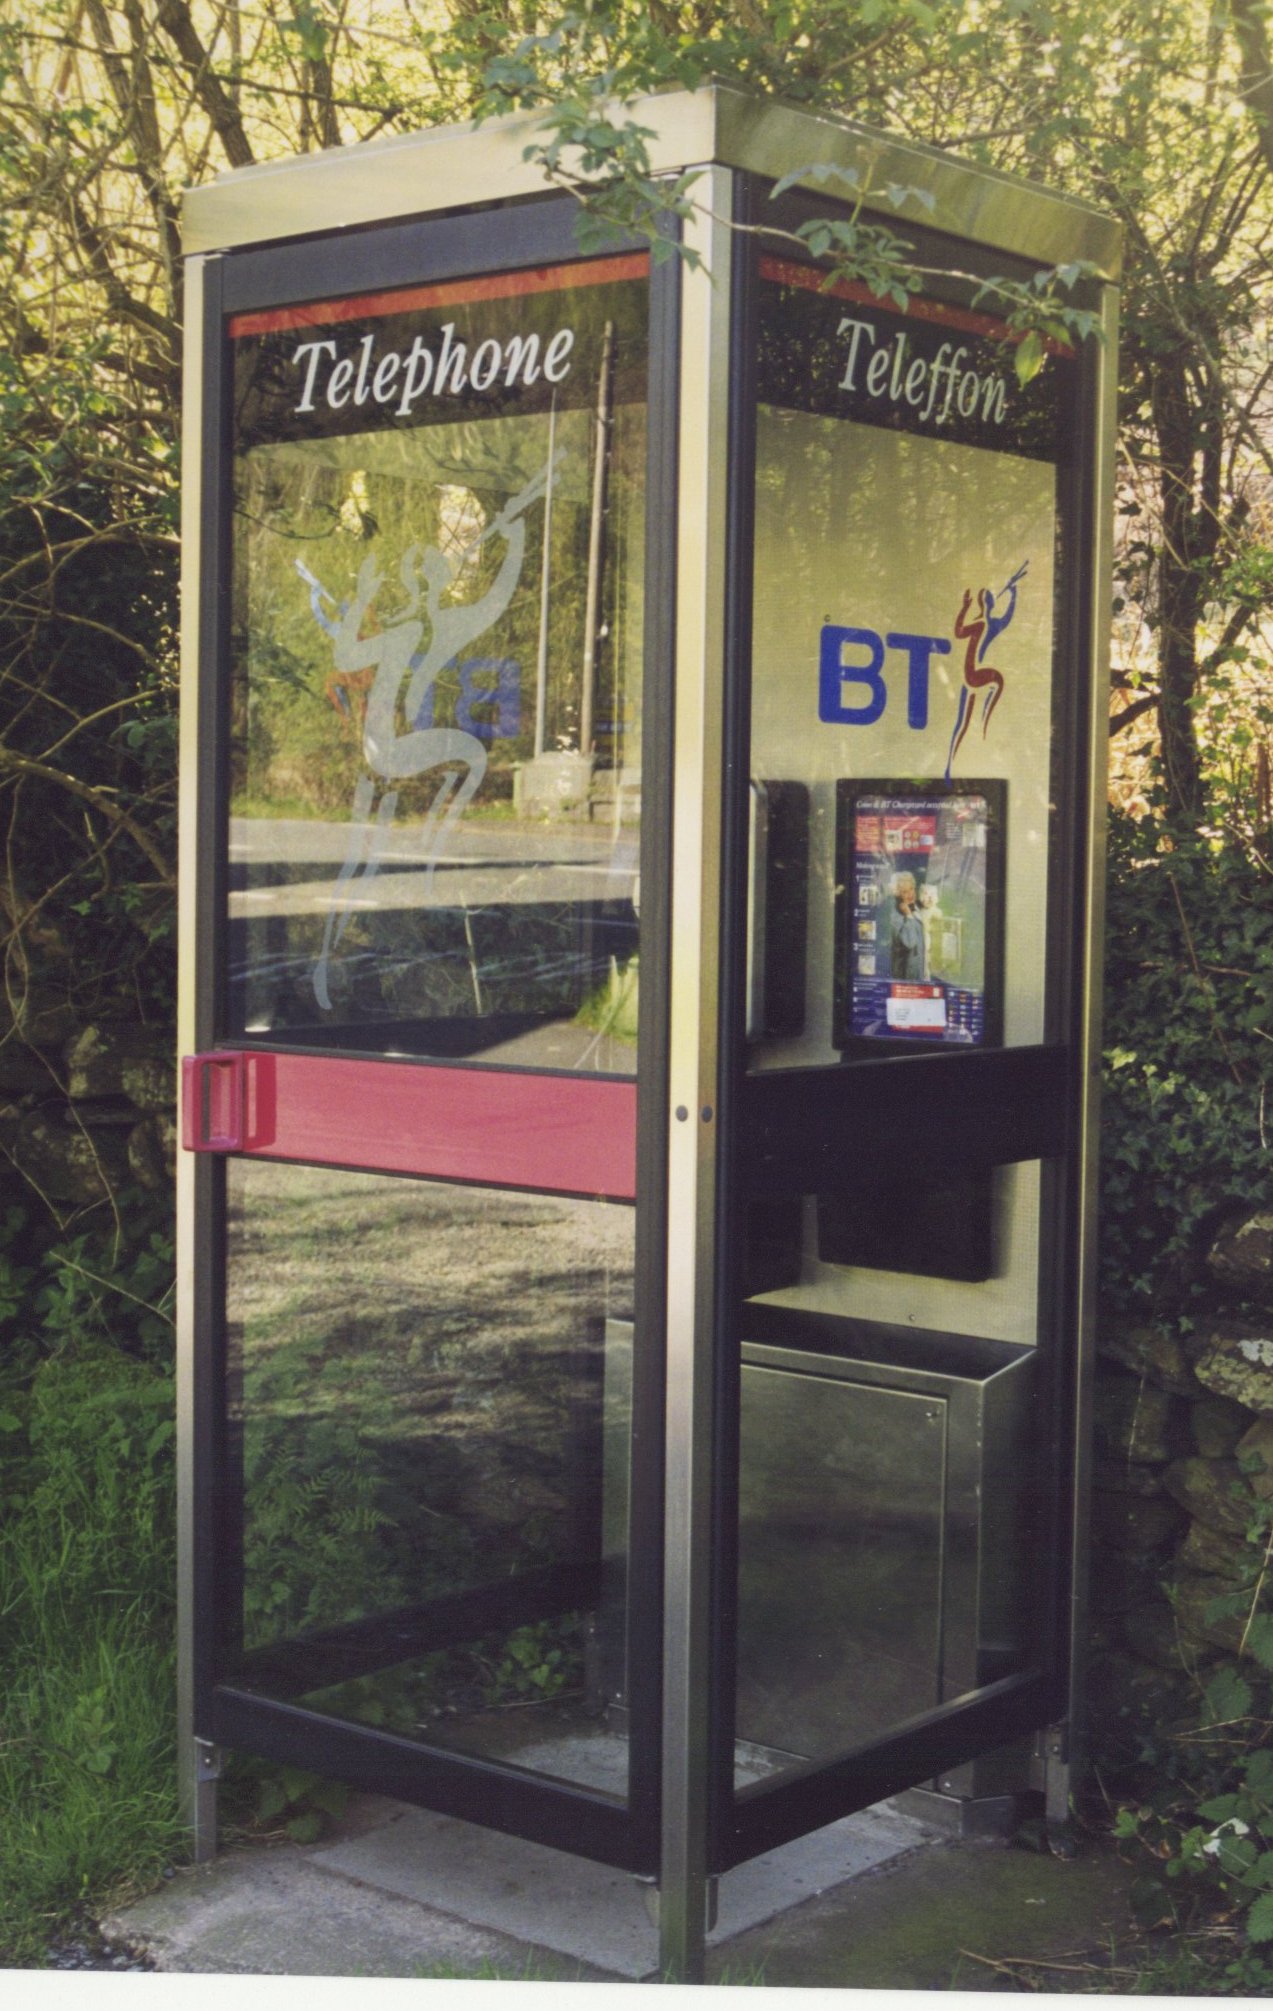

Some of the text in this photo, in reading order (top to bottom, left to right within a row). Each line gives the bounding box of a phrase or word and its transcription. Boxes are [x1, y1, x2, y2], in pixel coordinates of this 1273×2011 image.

[292, 321, 574, 416] Telephone
[836, 316, 1006, 425] Teleffon
[818, 624, 952, 730] BT
